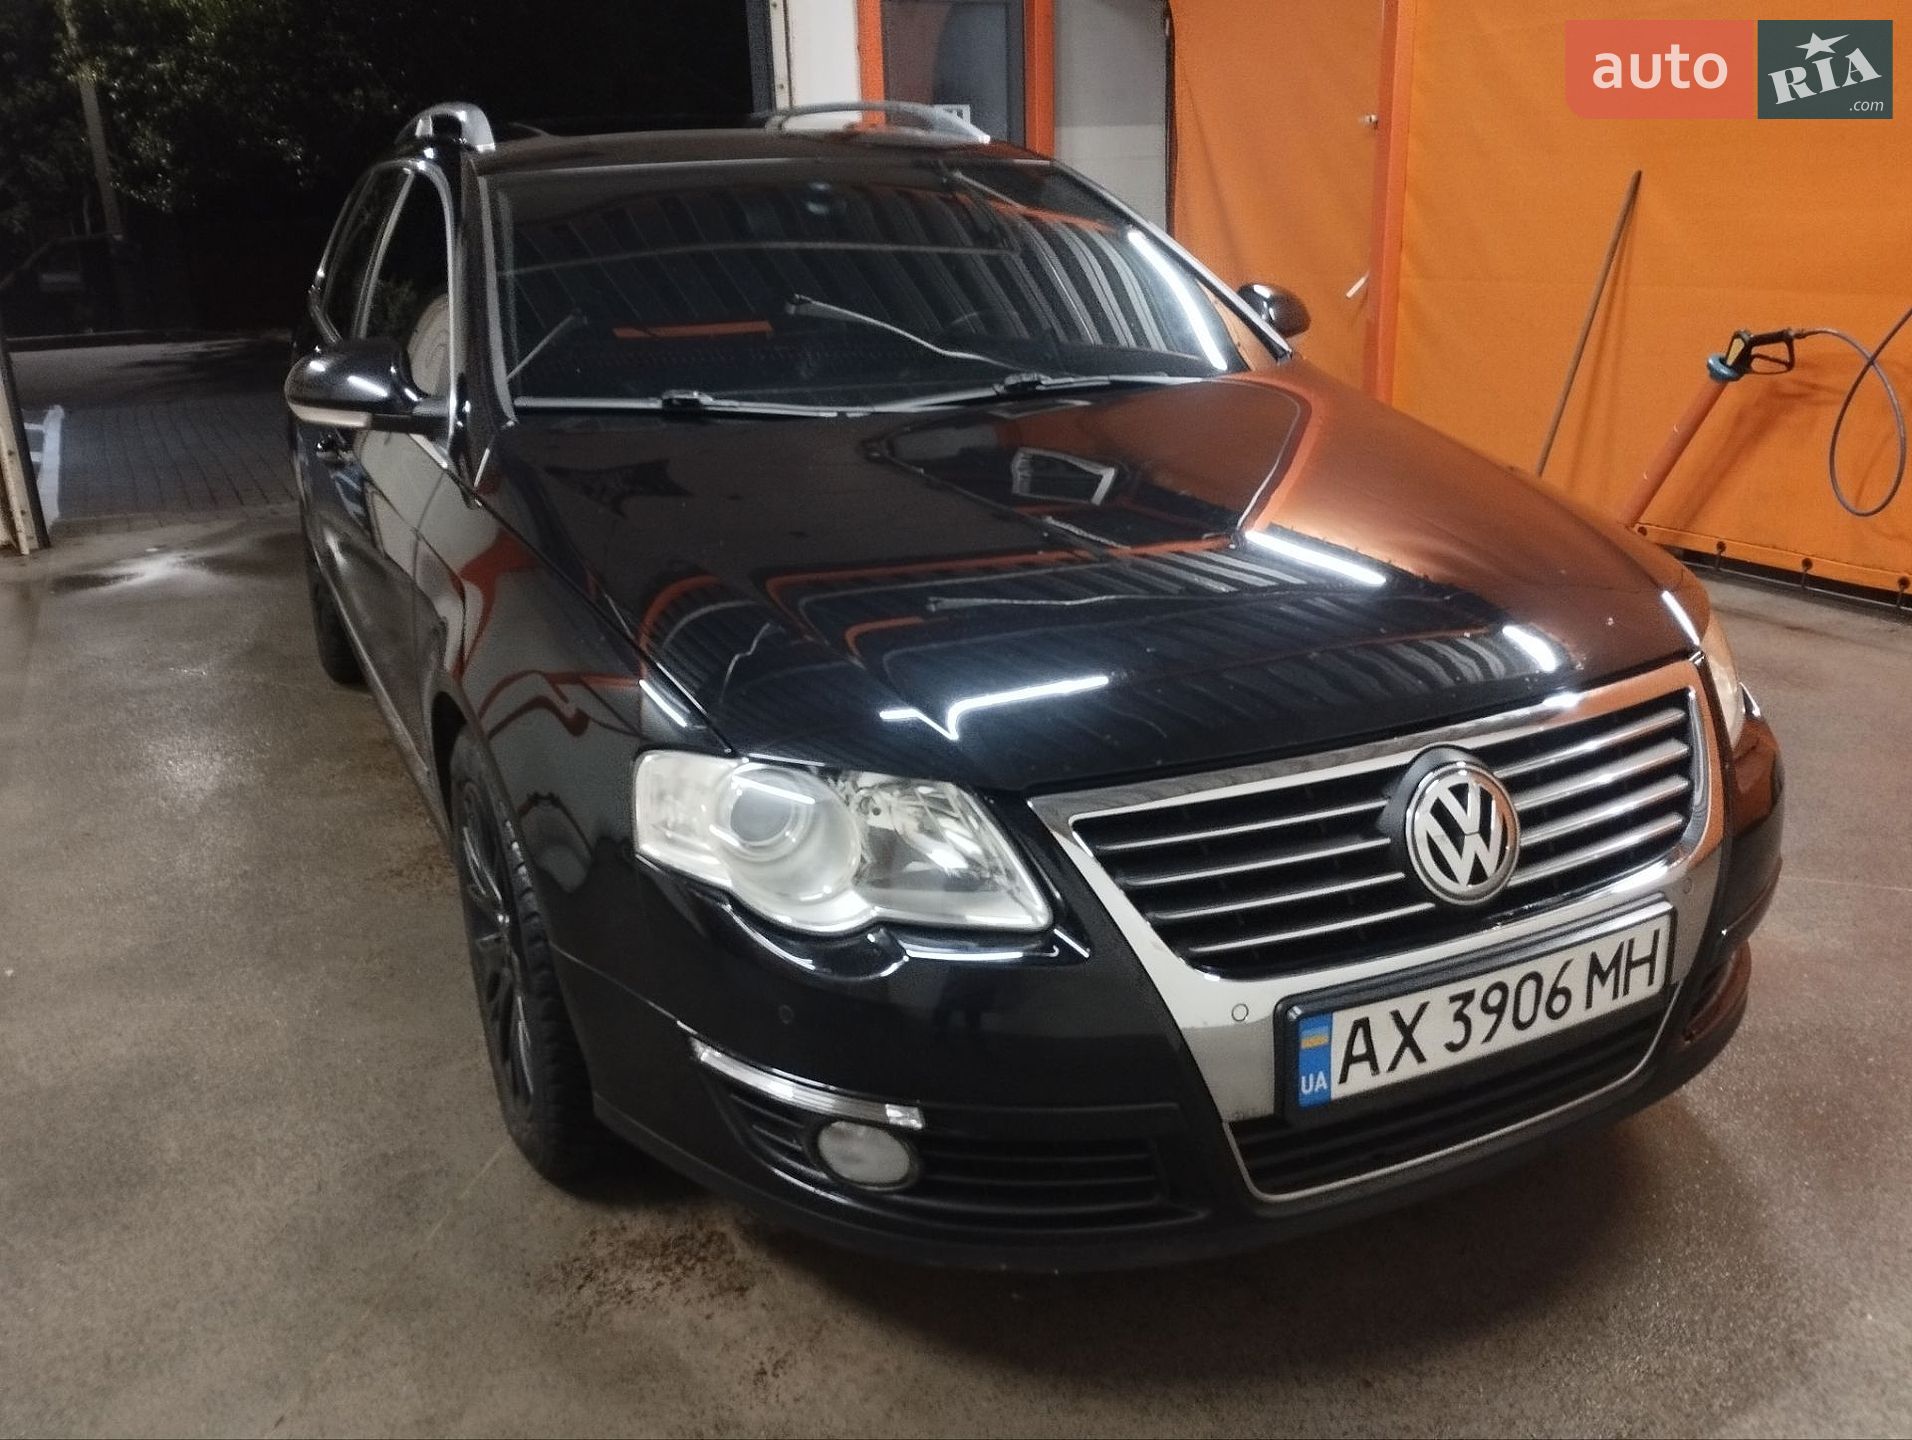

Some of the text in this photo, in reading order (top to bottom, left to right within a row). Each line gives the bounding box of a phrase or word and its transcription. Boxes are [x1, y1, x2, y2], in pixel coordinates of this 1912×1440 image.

[1413, 768, 1513, 892] VW
[1338, 928, 1661, 1085] AX 3906 MH
[1300, 1072, 1329, 1095] UA
